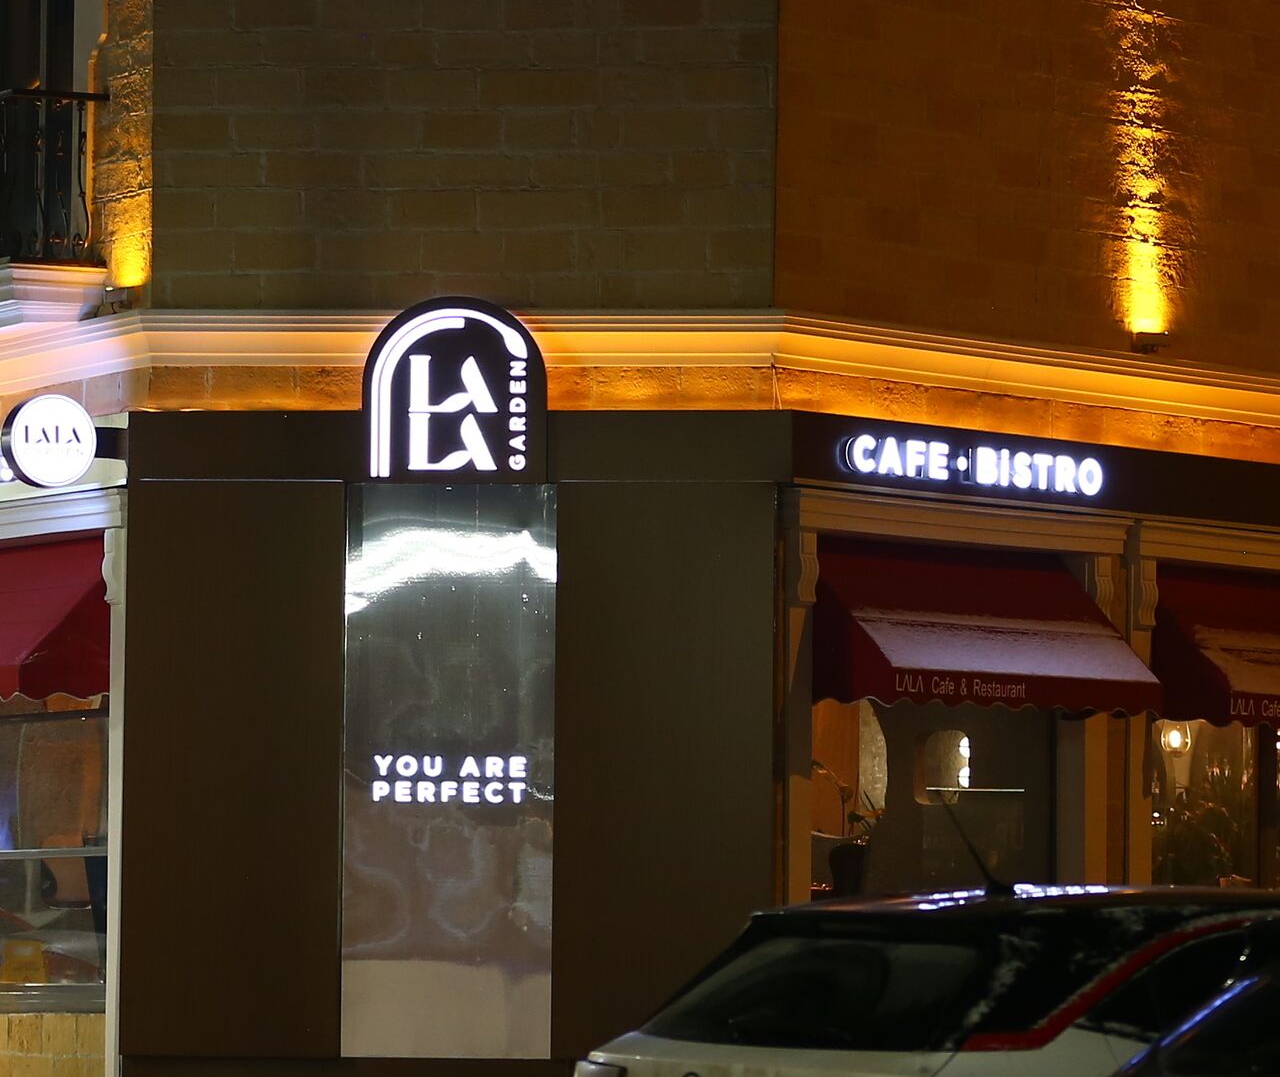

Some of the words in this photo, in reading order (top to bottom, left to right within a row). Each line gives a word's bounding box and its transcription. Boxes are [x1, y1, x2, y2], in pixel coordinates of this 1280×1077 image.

[508, 359, 527, 471] GARDEN
[851, 434, 950, 482] CAFE
[975, 446, 1104, 496] BISTRO
[895, 673, 924, 693] LALA
[931, 676, 955, 695] Cafe
[960, 678, 968, 696] &
[973, 679, 1026, 698] Restaurant
[373, 754, 443, 777] YOU
[459, 755, 528, 778] ARE
[372, 780, 527, 804] PERFECT
